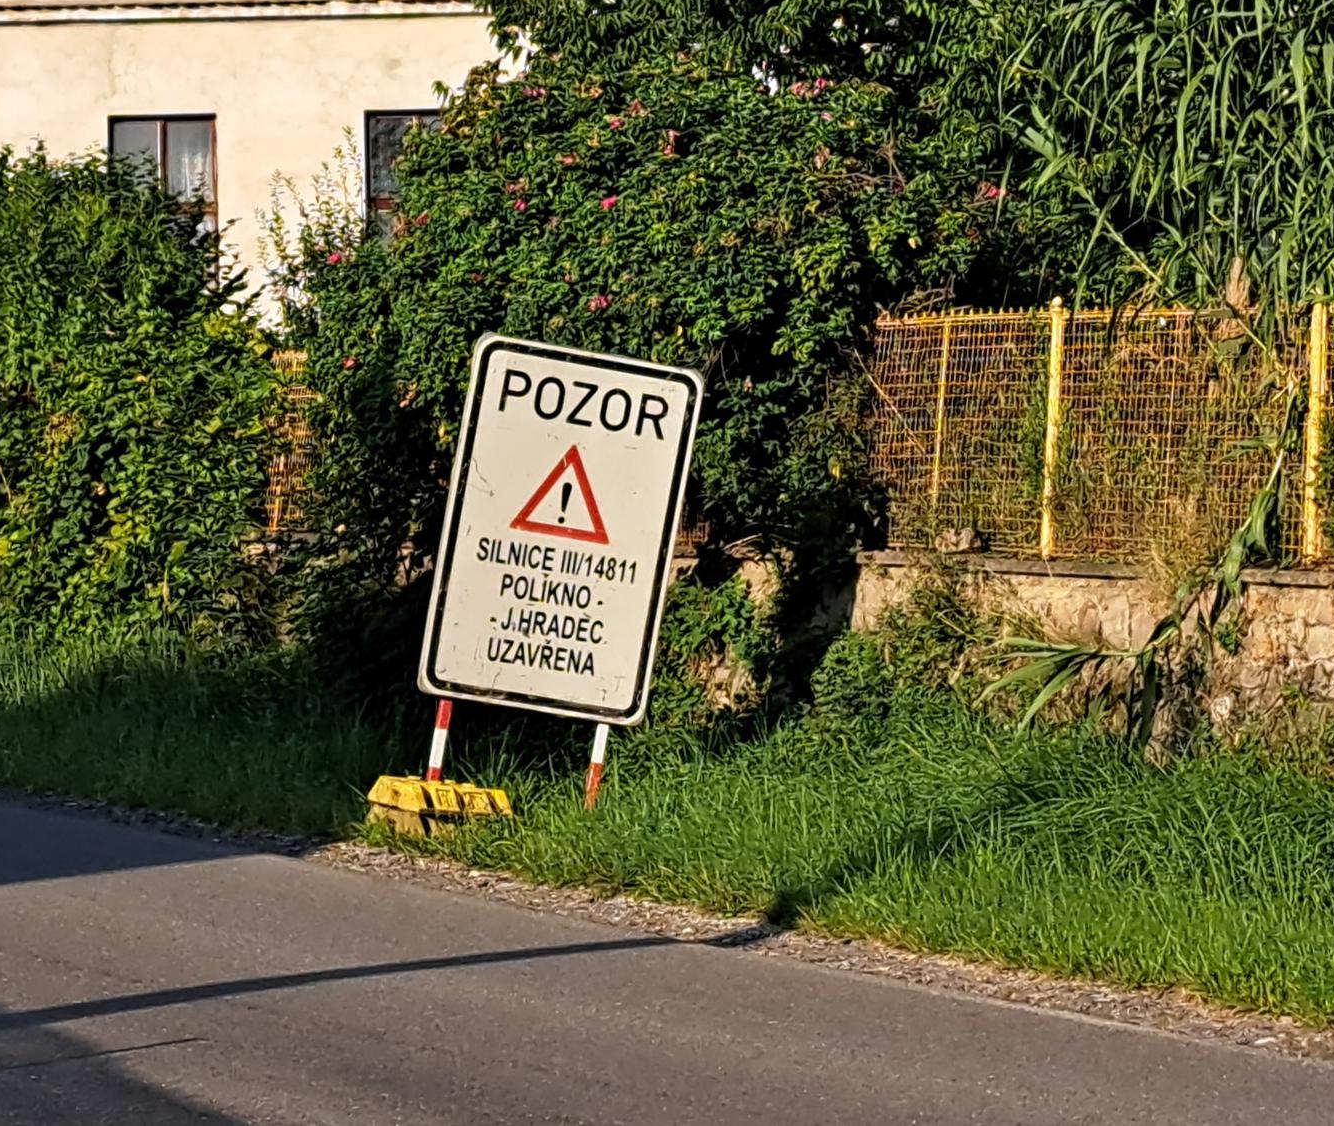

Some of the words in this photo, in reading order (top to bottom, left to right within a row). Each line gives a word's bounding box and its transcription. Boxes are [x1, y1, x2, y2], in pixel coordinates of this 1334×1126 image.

[498, 368, 669, 441] POZOR
[476, 536, 556, 572] SILNICE
[560, 549, 637, 584] III/14811
[486, 637, 596, 677] UZAVŘENA
